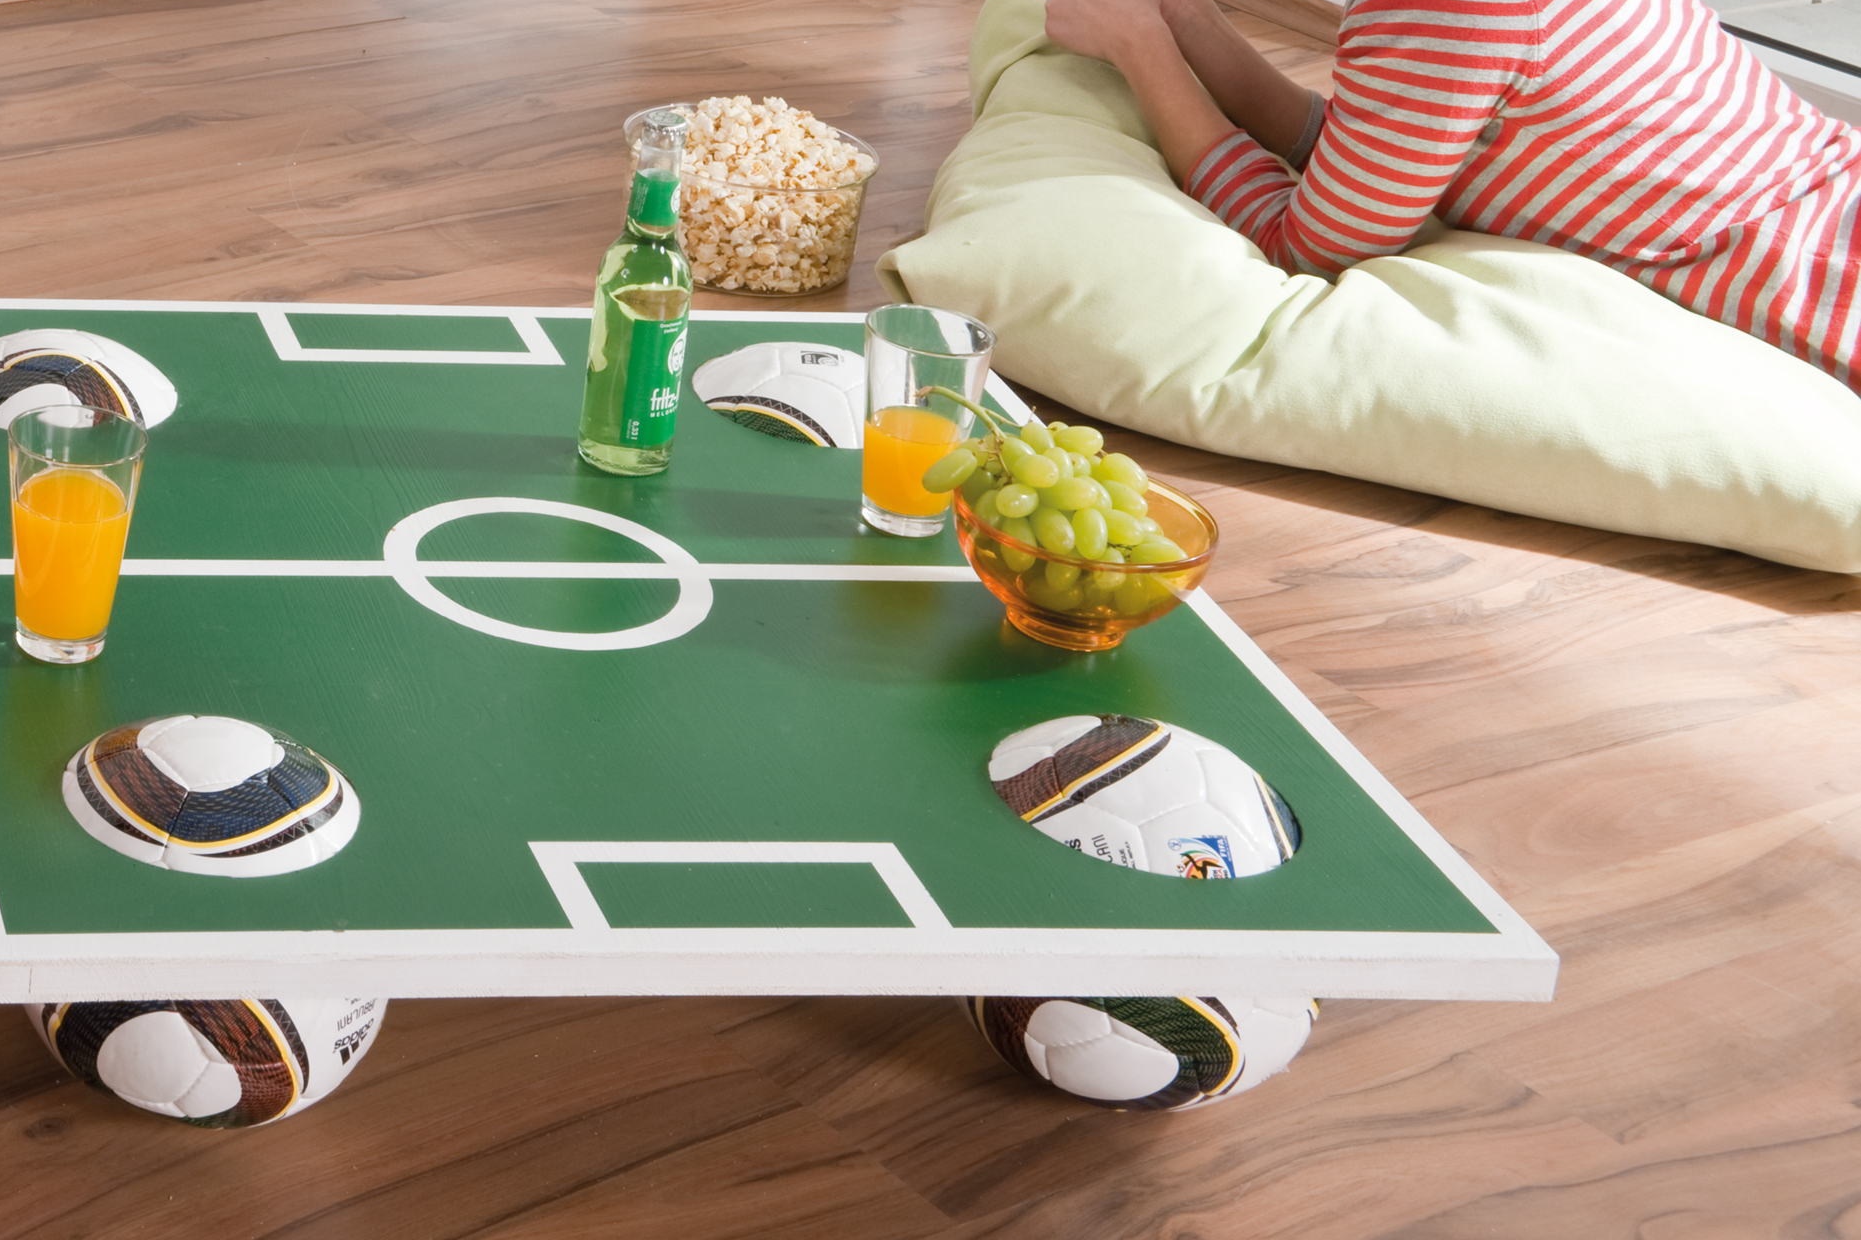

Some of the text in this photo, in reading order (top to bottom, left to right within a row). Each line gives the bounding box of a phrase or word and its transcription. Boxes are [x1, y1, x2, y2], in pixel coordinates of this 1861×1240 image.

[1217, 838, 1228, 858] FIFA
[337, 998, 378, 1031] ABULANI
[334, 1018, 374, 1050] adidas
